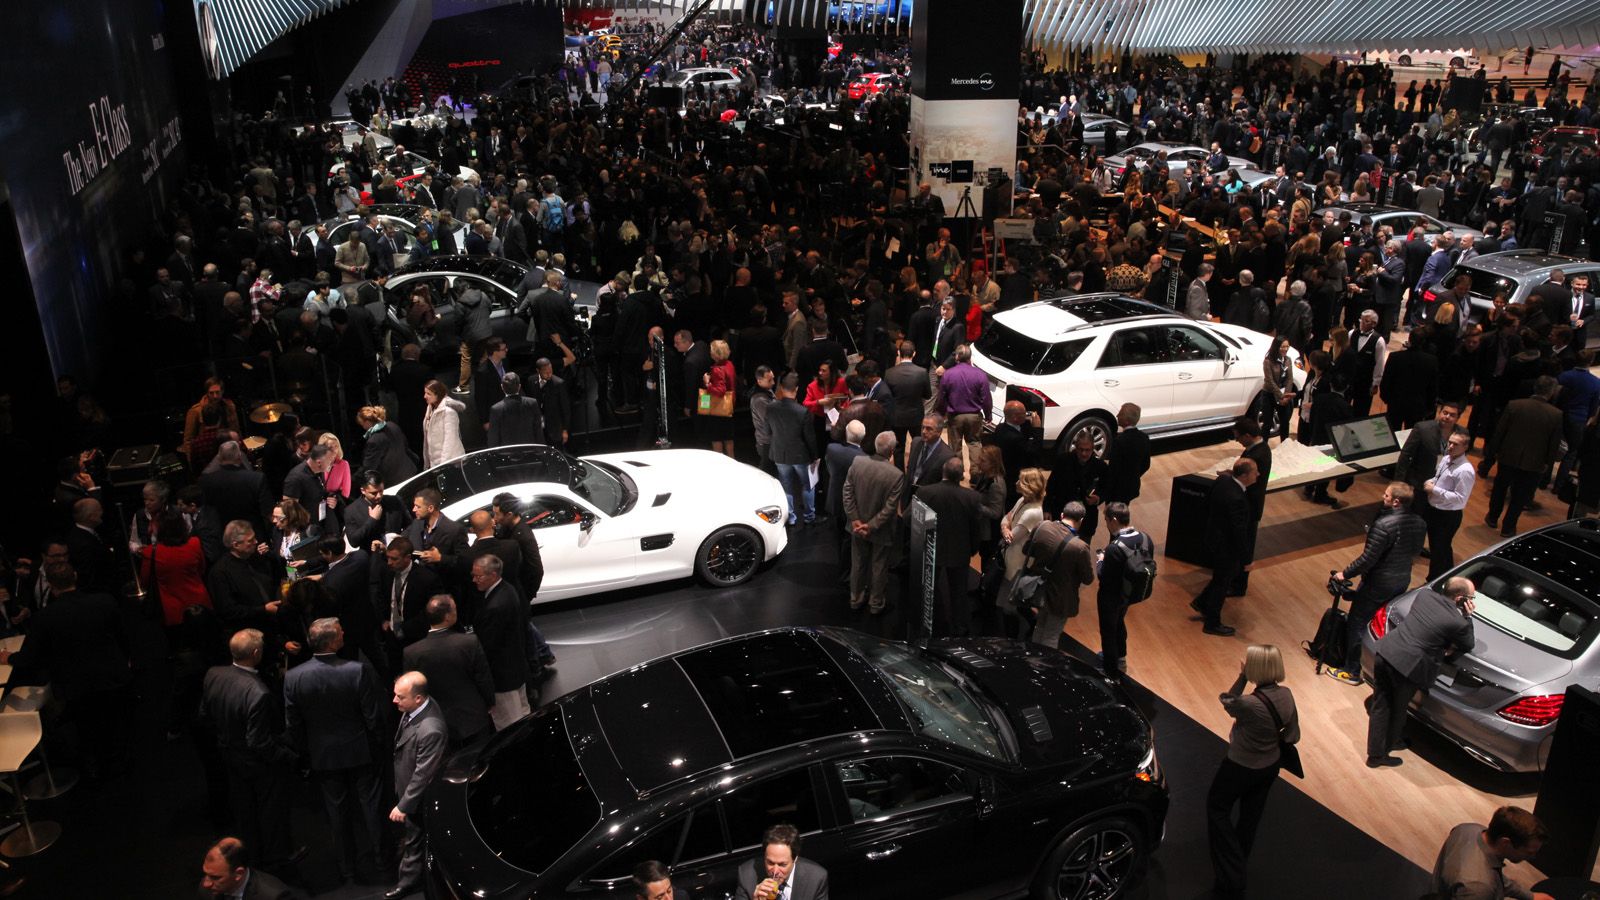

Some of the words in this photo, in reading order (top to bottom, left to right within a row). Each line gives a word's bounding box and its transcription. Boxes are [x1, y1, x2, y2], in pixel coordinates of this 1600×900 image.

[448, 59, 501, 68] quattro
[950, 77, 979, 85] Mercedes
[63, 150, 85, 195] The
[78, 140, 99, 183] New
[89, 95, 131, 168] E-Class
